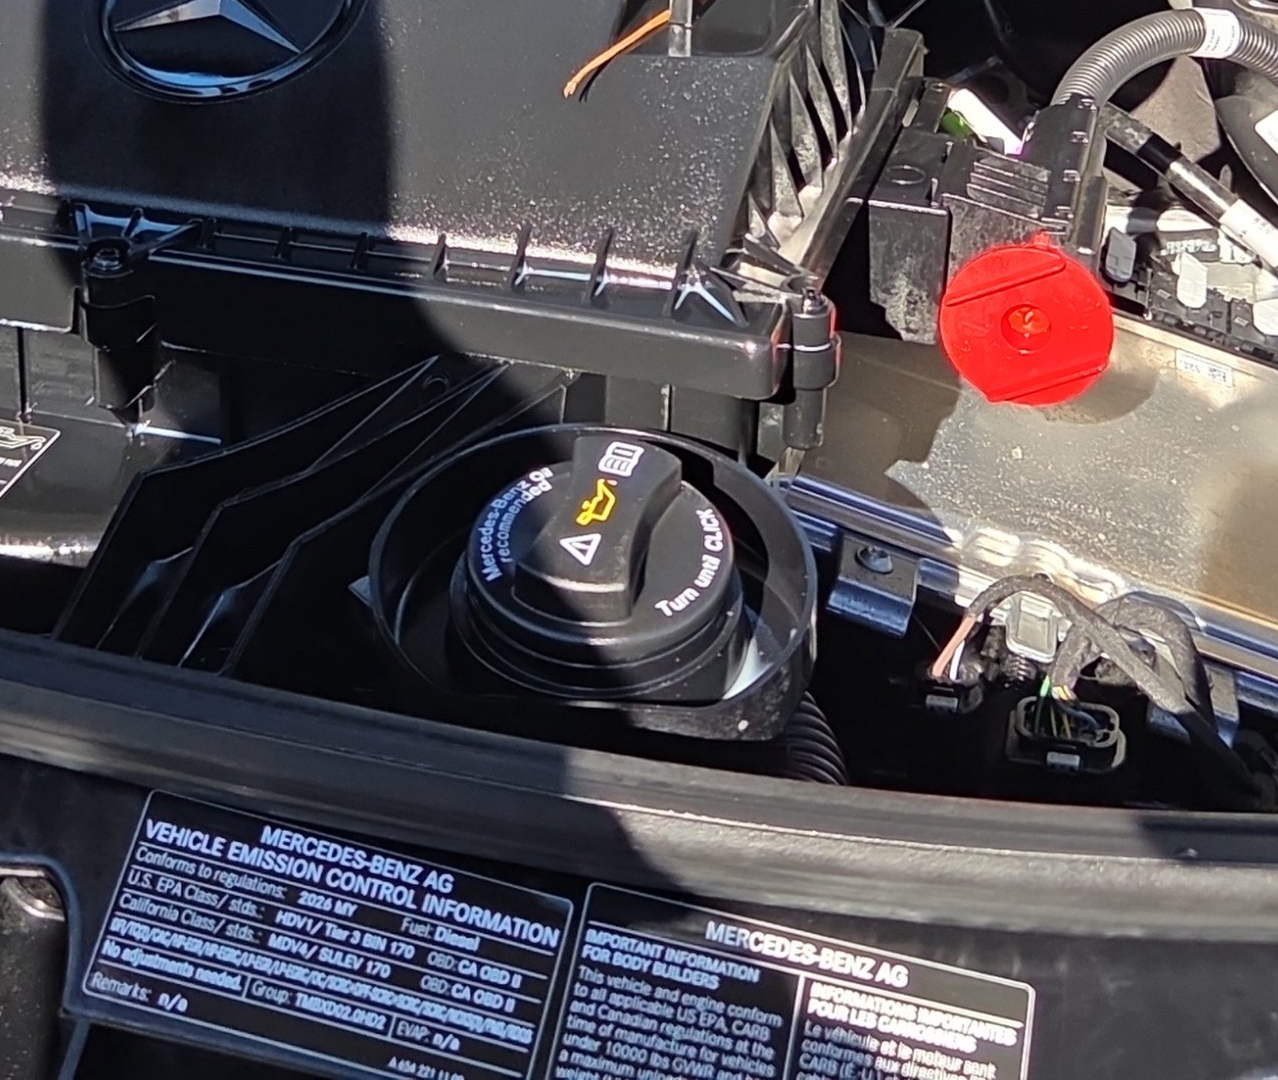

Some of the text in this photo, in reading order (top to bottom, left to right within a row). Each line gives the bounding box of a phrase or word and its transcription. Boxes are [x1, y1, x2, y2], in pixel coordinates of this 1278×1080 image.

[478, 480, 532, 582] Mercedes-Benz
[496, 479, 553, 563] recommended
[654, 508, 724, 617] Turn until CLICK
[133, 845, 359, 918] Conforms to regulations: 2026 MY
[141, 817, 561, 948] VEHICLE EMISSION CONTROL INFORMATION
[258, 824, 455, 894] MERCEDES-BENZ AG
[117, 892, 180, 922] California
[177, 908, 225, 935] Class/
[265, 931, 318, 961] MDV4/
[316, 945, 364, 972] SULEV
[363, 958, 393, 980] 170
[125, 868, 156, 890] U.S.
[154, 876, 185, 898] EPA
[181, 883, 229, 911] Class/
[273, 908, 324, 937] HDV1/
[322, 921, 352, 943] Tier
[348, 928, 362, 945] 3
[360, 931, 388, 952] BIN
[387, 938, 417, 960] 170
[399, 916, 481, 952] Fuel: Diesel
[99, 938, 123, 959] No
[118, 944, 196, 982] adjustments
[425, 949, 459, 972] OBD:
[455, 958, 480, 978] CA
[477, 964, 511, 986] OBD
[580, 944, 721, 991] FOR BODY BUILDERS
[584, 927, 761, 984] IMPORTANT INFORMATION
[703, 919, 910, 989] MERCEDES-BENZ AG
[89, 970, 191, 1015] Remarks: n/a
[248, 979, 294, 1008] Group:
[418, 974, 452, 996] OBD:
[449, 982, 473, 1002] CA
[471, 988, 505, 1011] OBD
[572, 982, 771, 1042] to all applicable US EPA, CARB
[575, 964, 783, 1027] This vehicle and engine conform
[394, 1019, 462, 1053] EVAP: n/a
[561, 1031, 601, 1053] under
[604, 1040, 647, 1064] 10000
[648, 1051, 670, 1069] lbs
[670, 1056, 715, 1079] GVWR
[565, 1014, 597, 1035] time
[596, 1022, 614, 1038] of
[613, 1025, 698, 1058] manufacture
[698, 1045, 719, 1063] for
[719, 1050, 776, 1079] vehicles
[568, 998, 776, 1061] and Canadian regulations at the
[388, 1056, 397, 1068] A
[416, 1063, 436, 1078] 221
[558, 1048, 569, 1062] a
[569, 1050, 635, 1078] maximum
[797, 1052, 839, 1077] CARB
